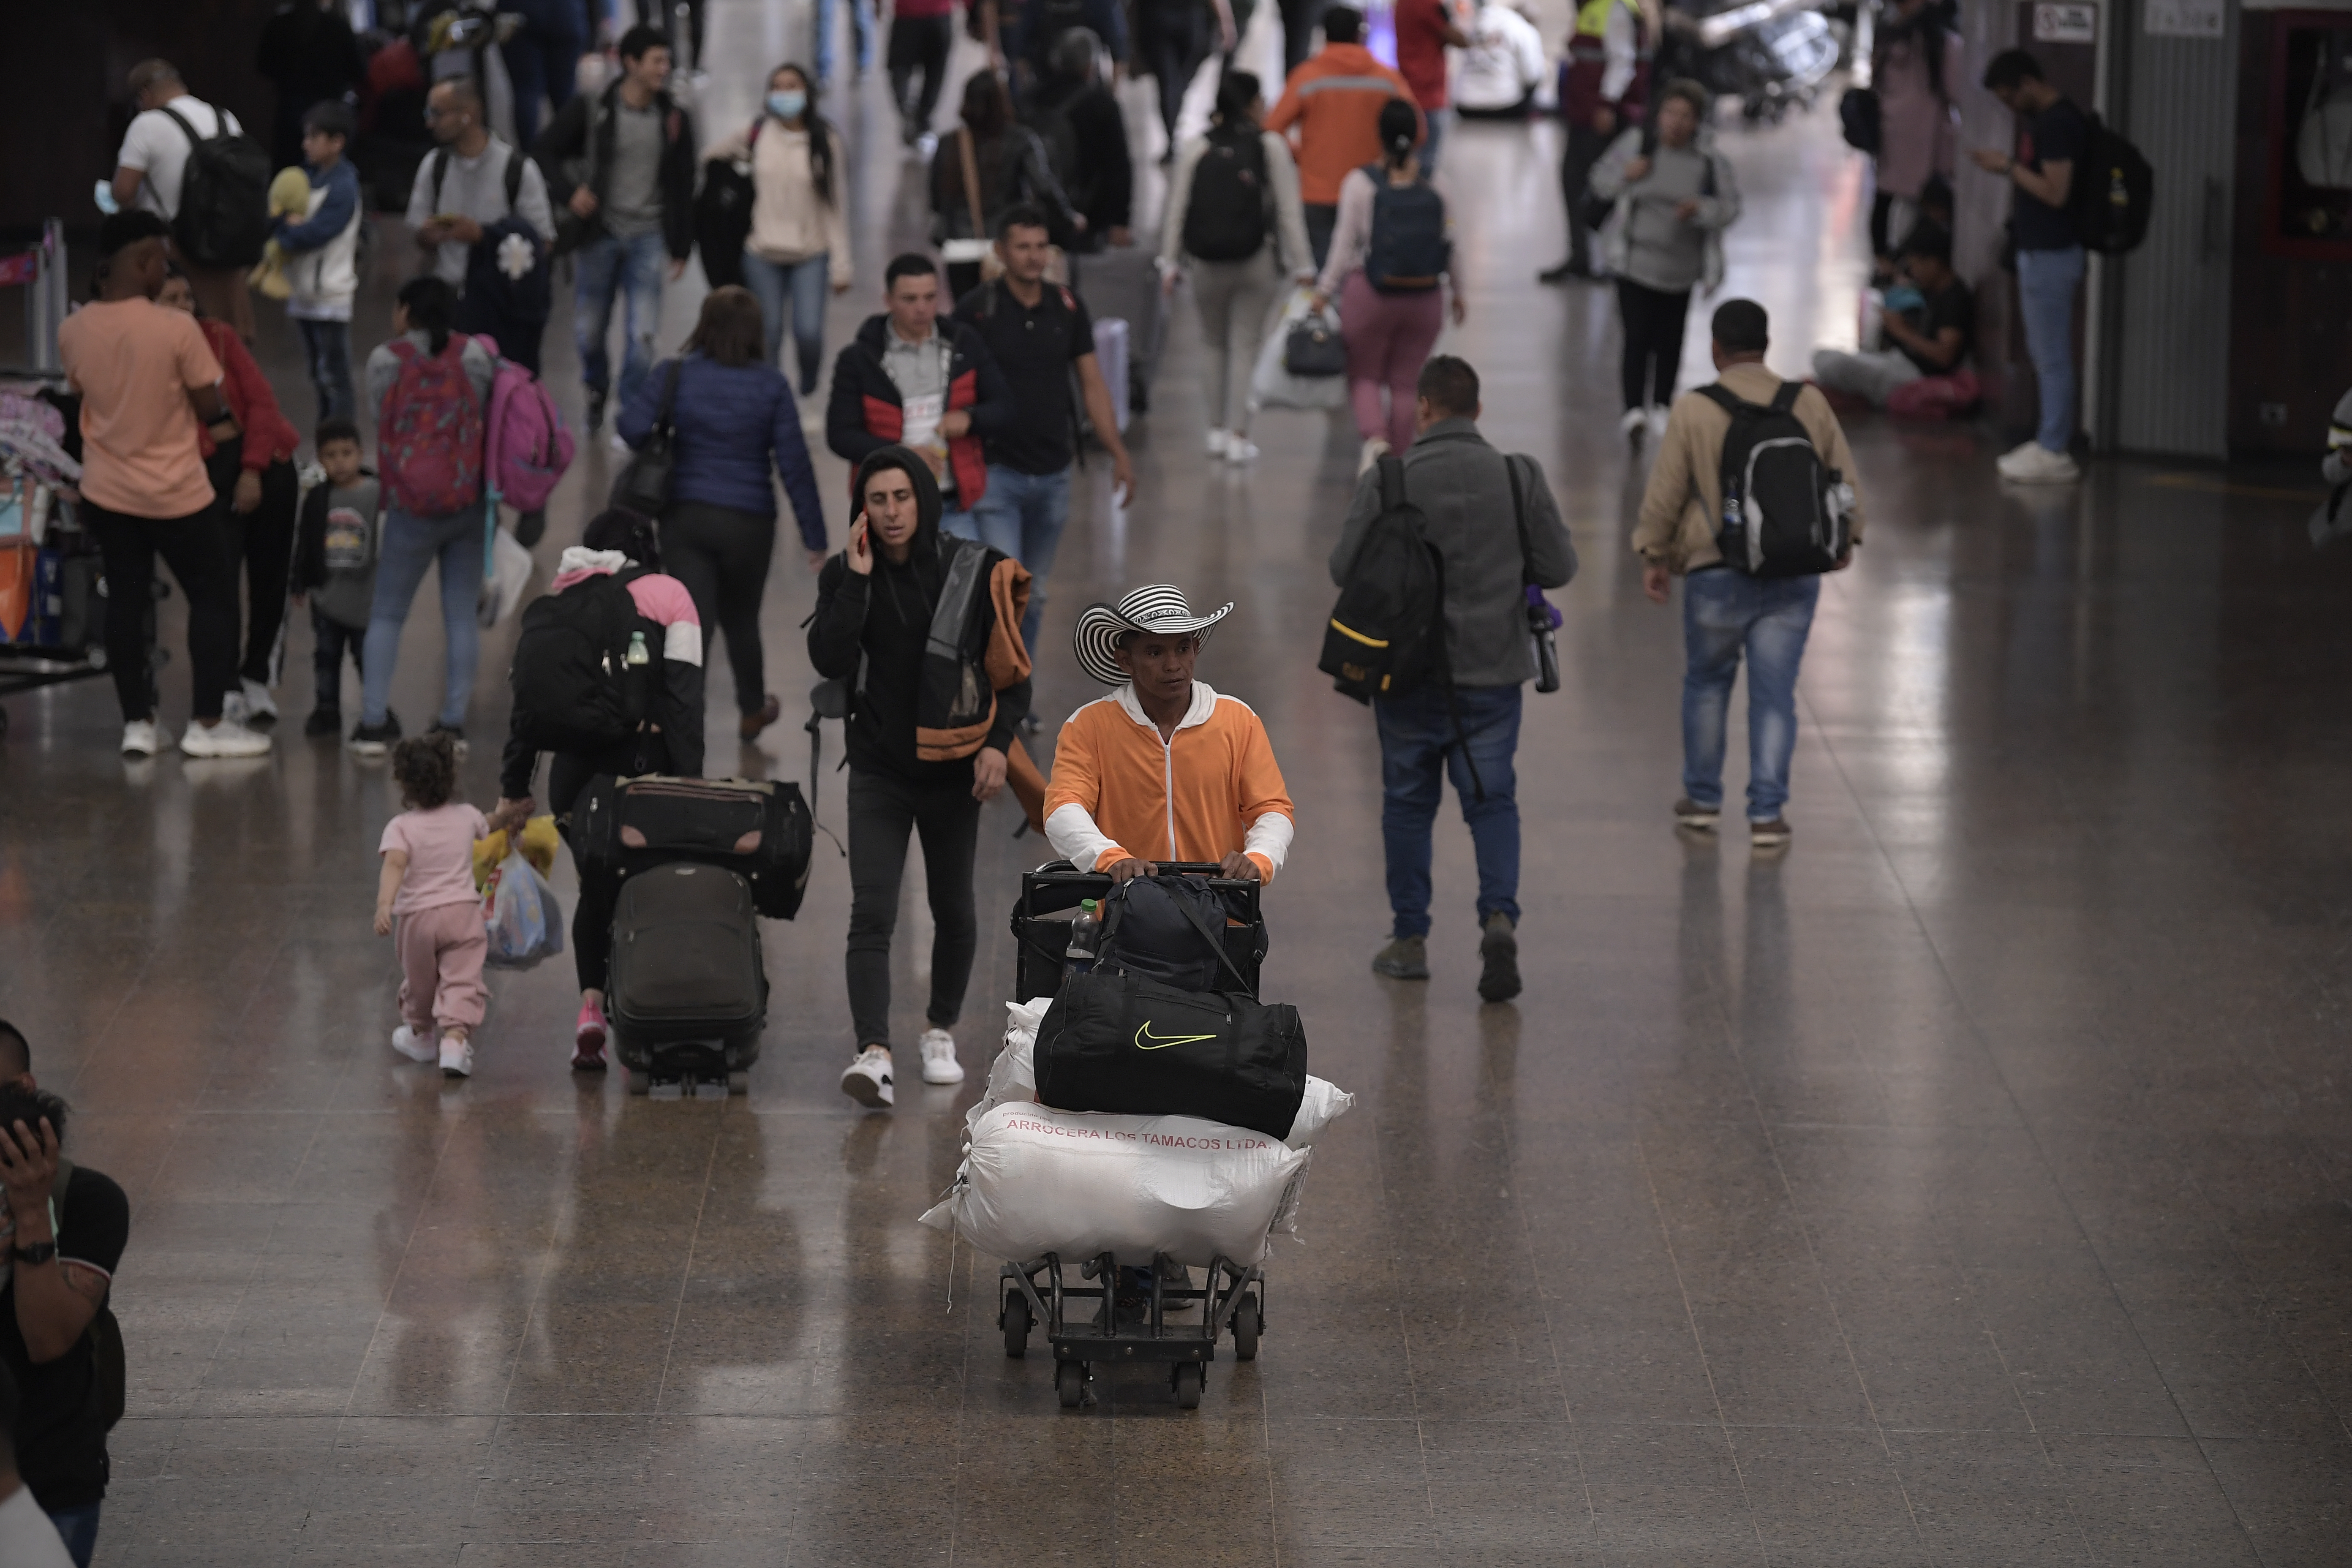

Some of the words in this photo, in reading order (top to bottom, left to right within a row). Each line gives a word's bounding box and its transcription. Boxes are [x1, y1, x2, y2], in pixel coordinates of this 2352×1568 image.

[1007, 1119, 1100, 1139] ARROCERA
[1105, 1131, 1136, 1141] LOS
[1141, 1133, 1220, 1150] TAMACOS
[1226, 1139, 1271, 1150] LTDA.
